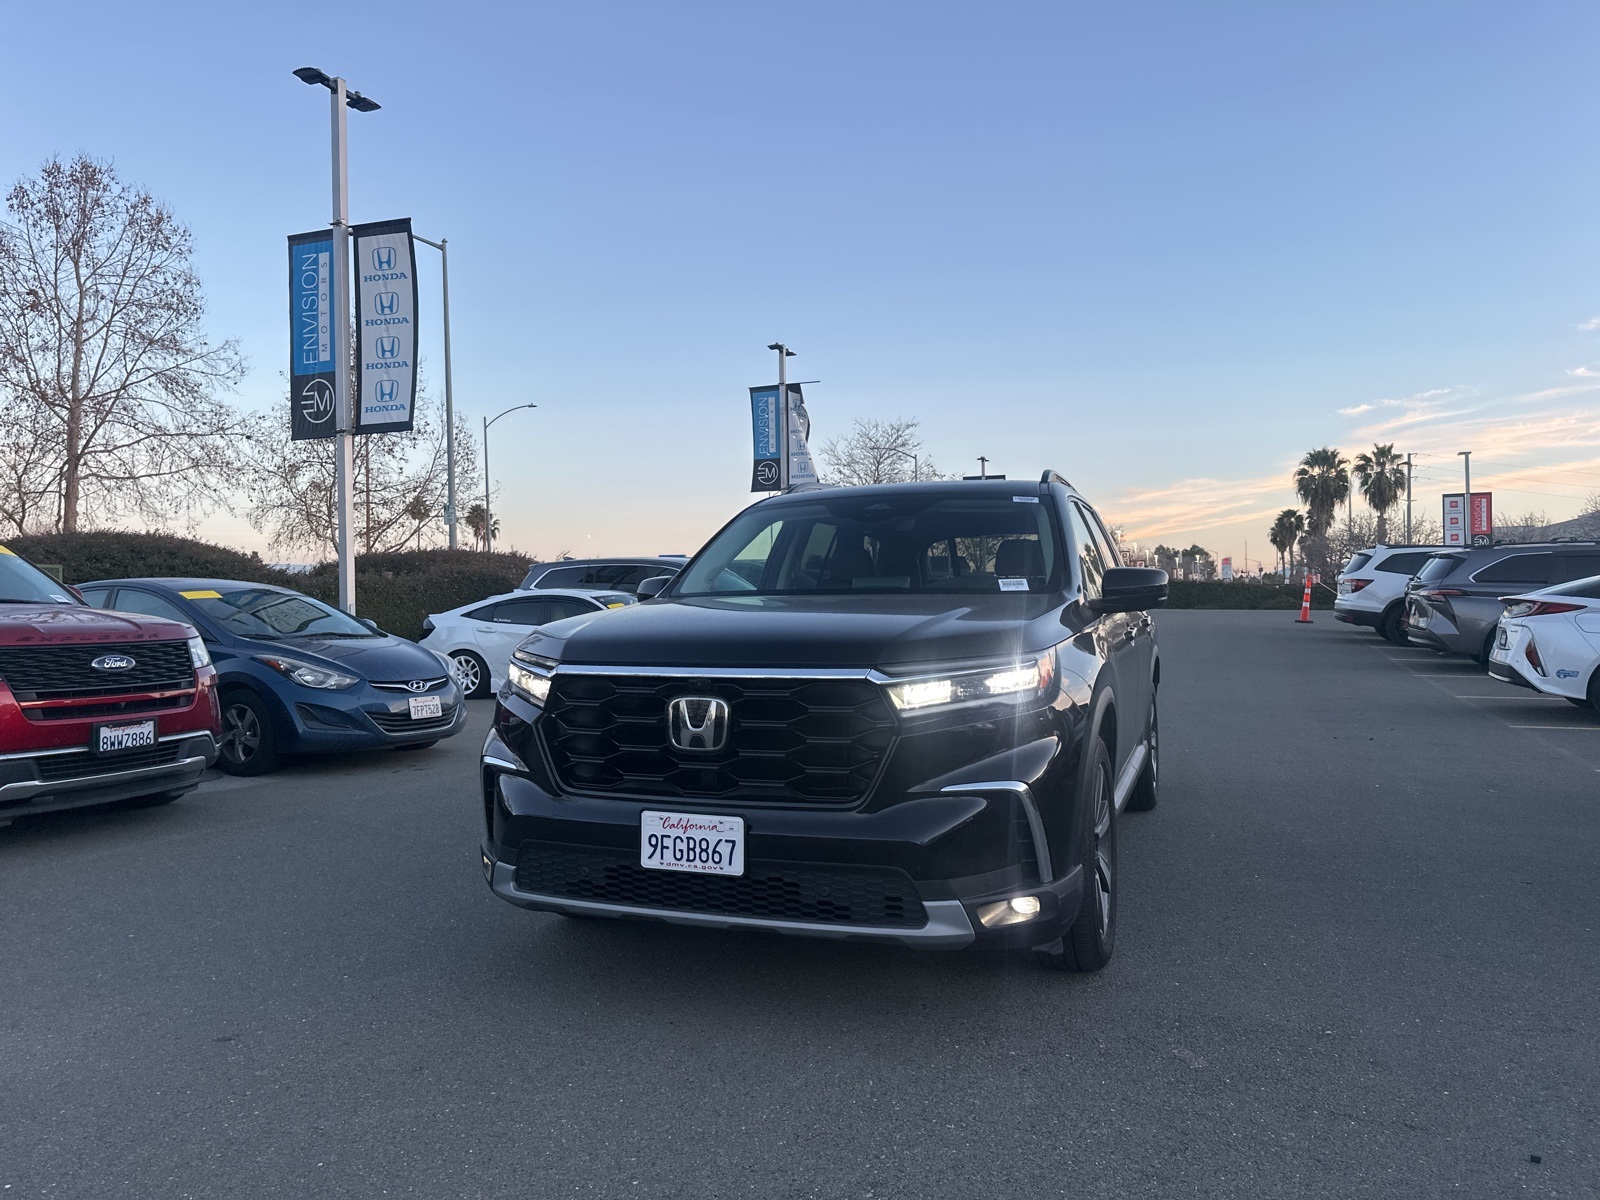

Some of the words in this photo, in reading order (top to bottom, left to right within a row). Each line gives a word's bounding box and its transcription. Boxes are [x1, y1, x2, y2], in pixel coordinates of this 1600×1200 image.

[363, 272, 408, 283] HONDA
[302, 253, 318, 364] ENVISION
[320, 261, 329, 352] MOTORS
[364, 316, 410, 327] HONDA
[365, 360, 409, 370] HONDA
[364, 403, 406, 414] HONDA
[758, 397, 769, 454] ENVISION
[1474, 498, 1482, 531] ENVISION
[104, 657, 128, 668] Ford
[412, 704, 440, 716] 7FPT528
[662, 816, 725, 834] California
[648, 833, 736, 867] 9FGB867
[666, 861, 718, 870] dmv.ca.gov
